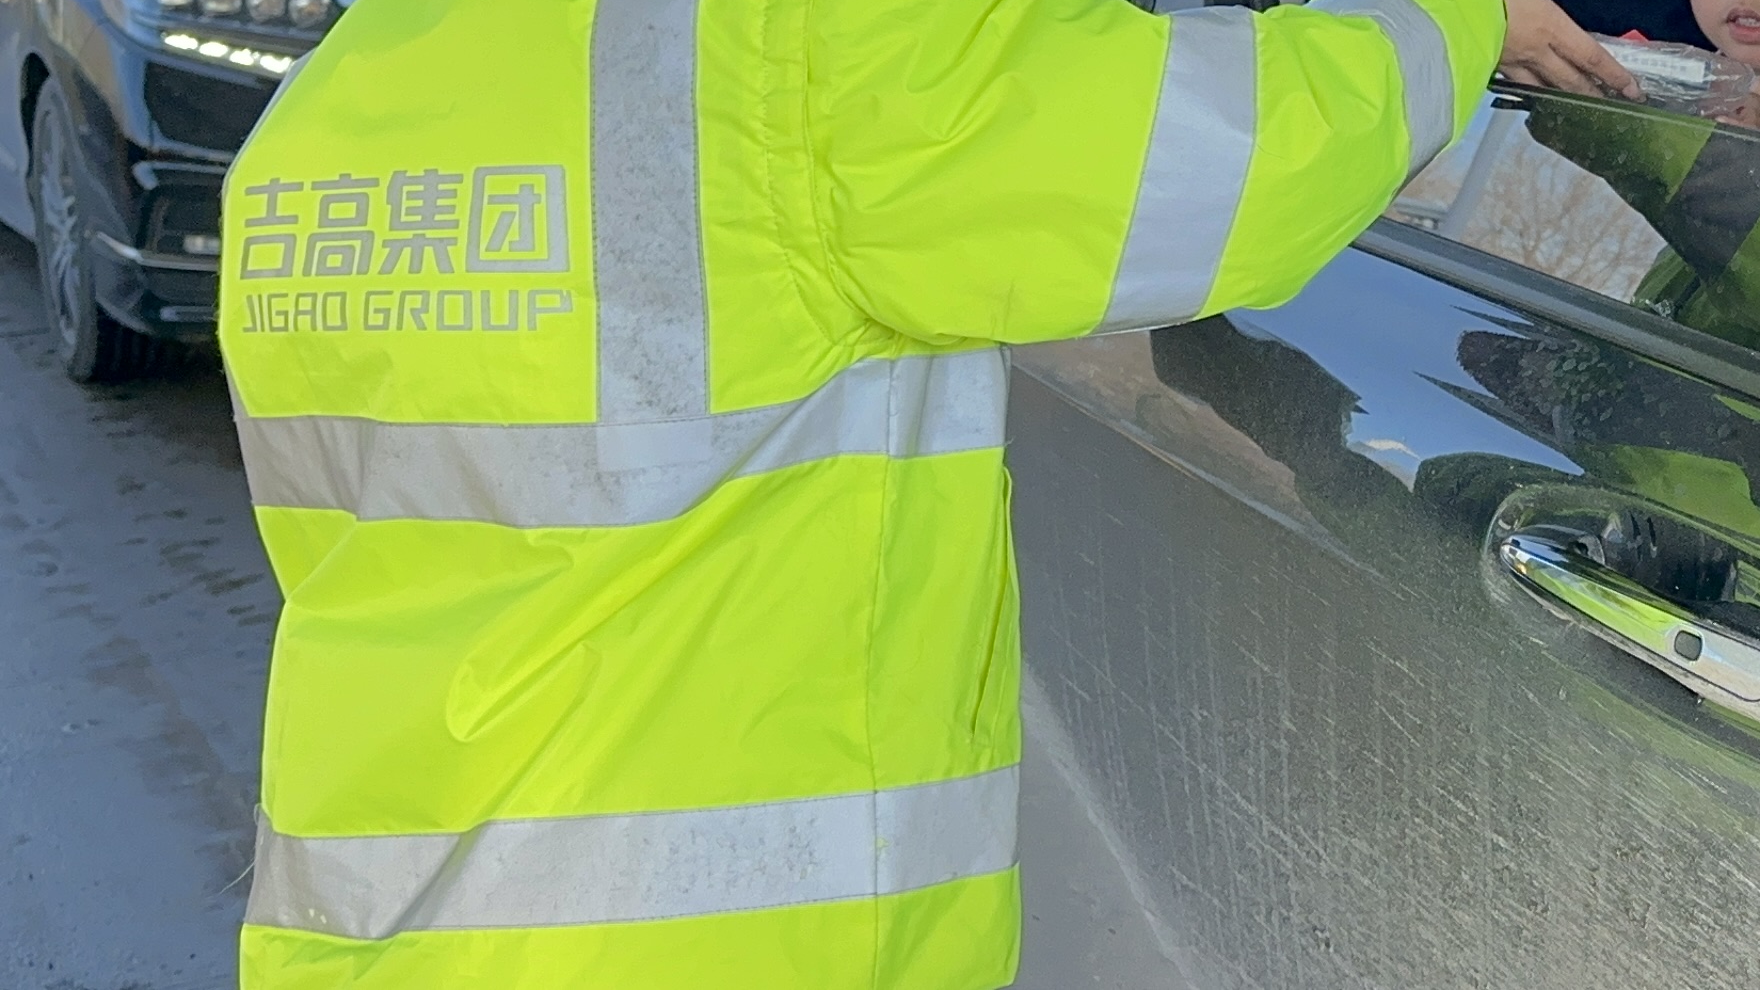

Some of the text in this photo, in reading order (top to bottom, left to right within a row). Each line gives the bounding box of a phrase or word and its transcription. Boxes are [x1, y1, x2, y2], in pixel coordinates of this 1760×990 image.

[241, 165, 571, 280] 吉高集团
[242, 289, 573, 333] JIGAO GROUP
